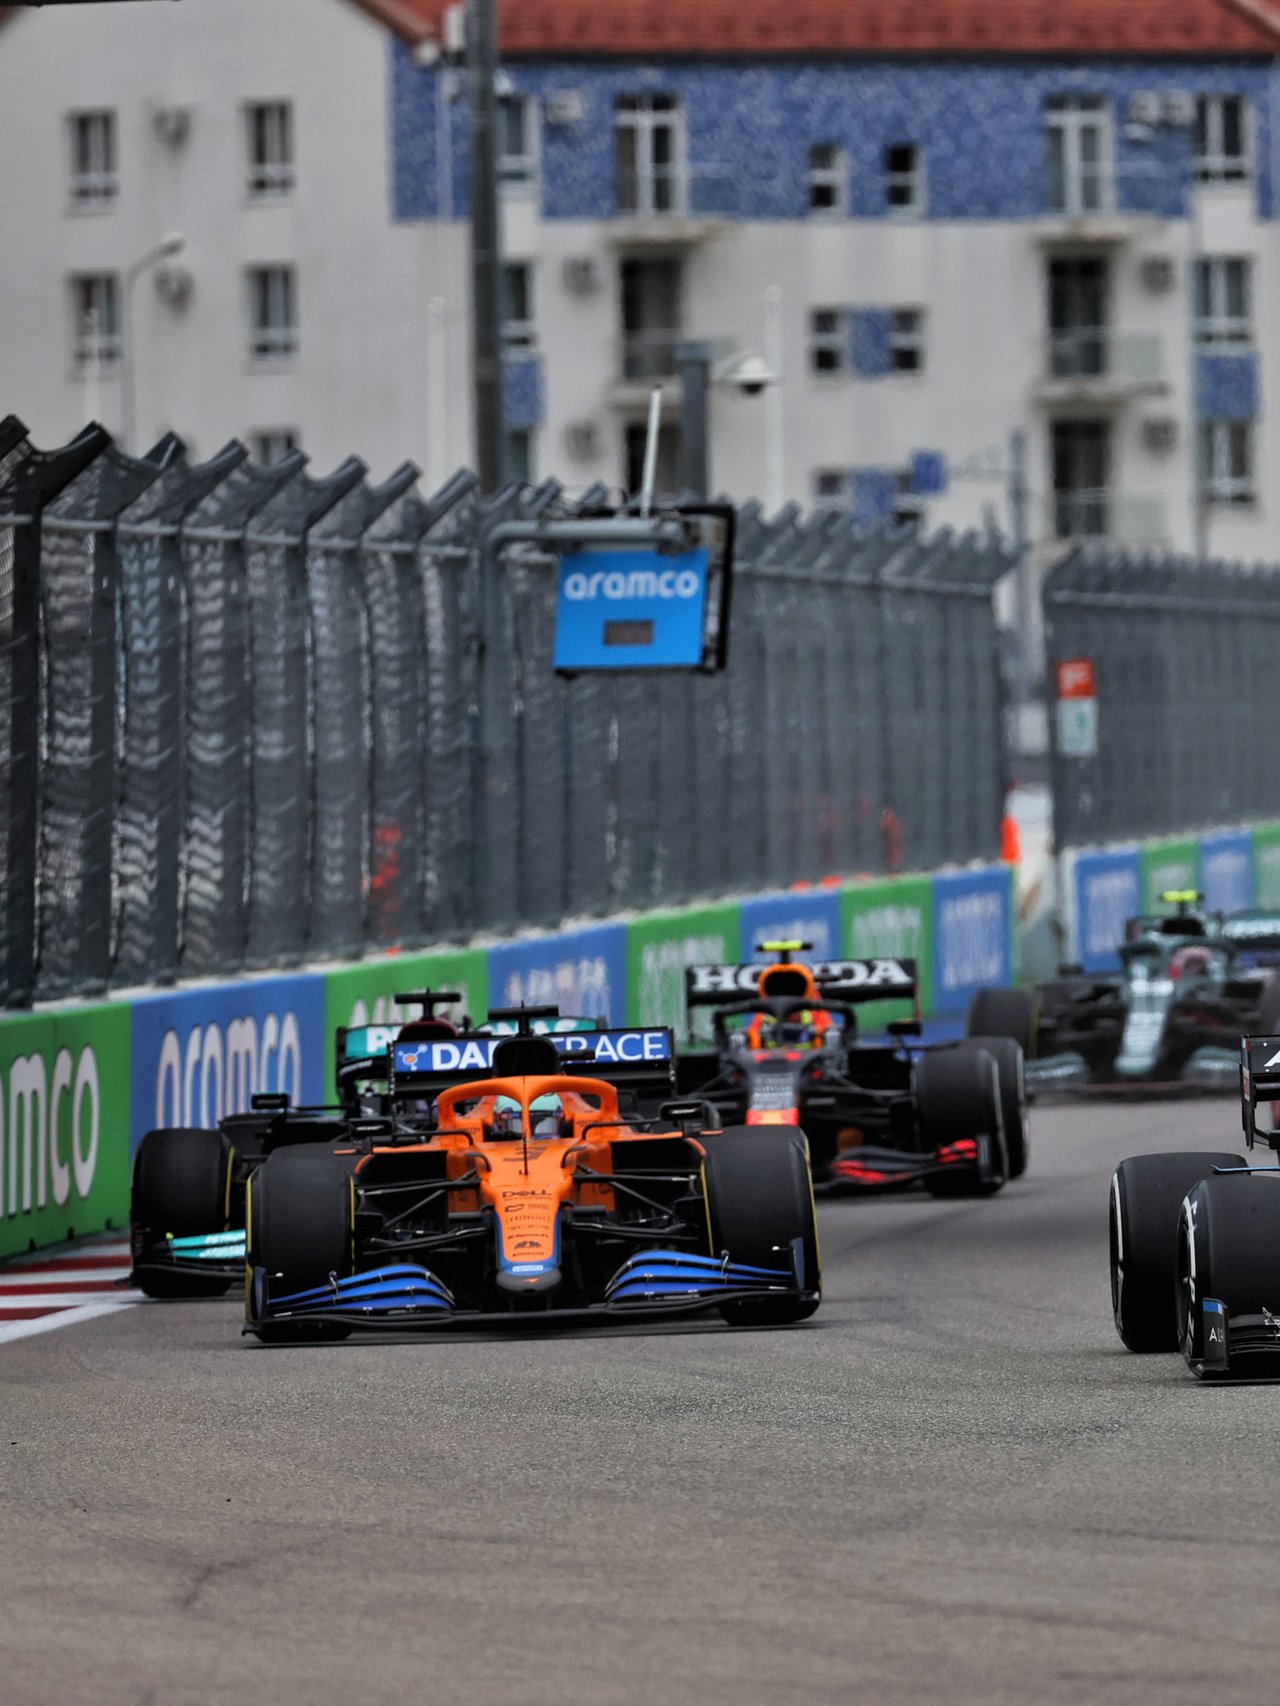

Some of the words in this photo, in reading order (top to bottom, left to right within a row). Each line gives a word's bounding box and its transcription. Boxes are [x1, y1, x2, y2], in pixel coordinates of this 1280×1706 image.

[564, 569, 699, 599] aramco
[693, 959, 912, 993] HODA
[0, 1044, 98, 1219] mco
